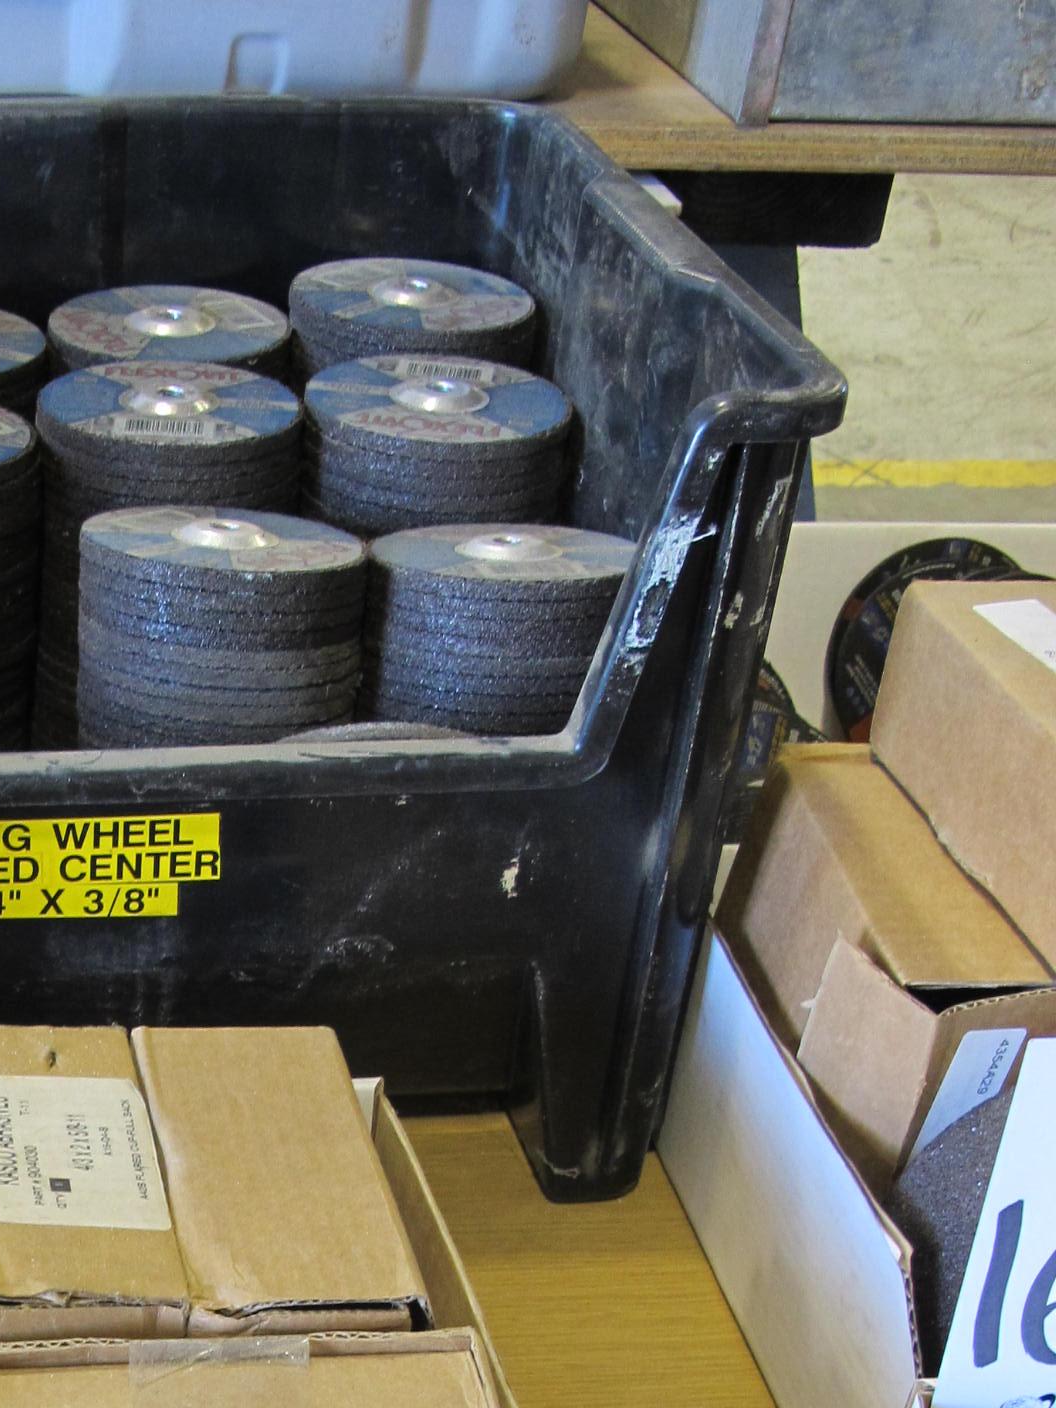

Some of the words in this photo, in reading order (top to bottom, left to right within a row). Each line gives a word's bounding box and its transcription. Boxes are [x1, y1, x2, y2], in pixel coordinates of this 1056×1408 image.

[52, 819, 194, 851] WHEEL
[59, 850, 220, 882] CENTER
[39, 888, 65, 916] X
[82, 887, 160, 919] 3/8"
